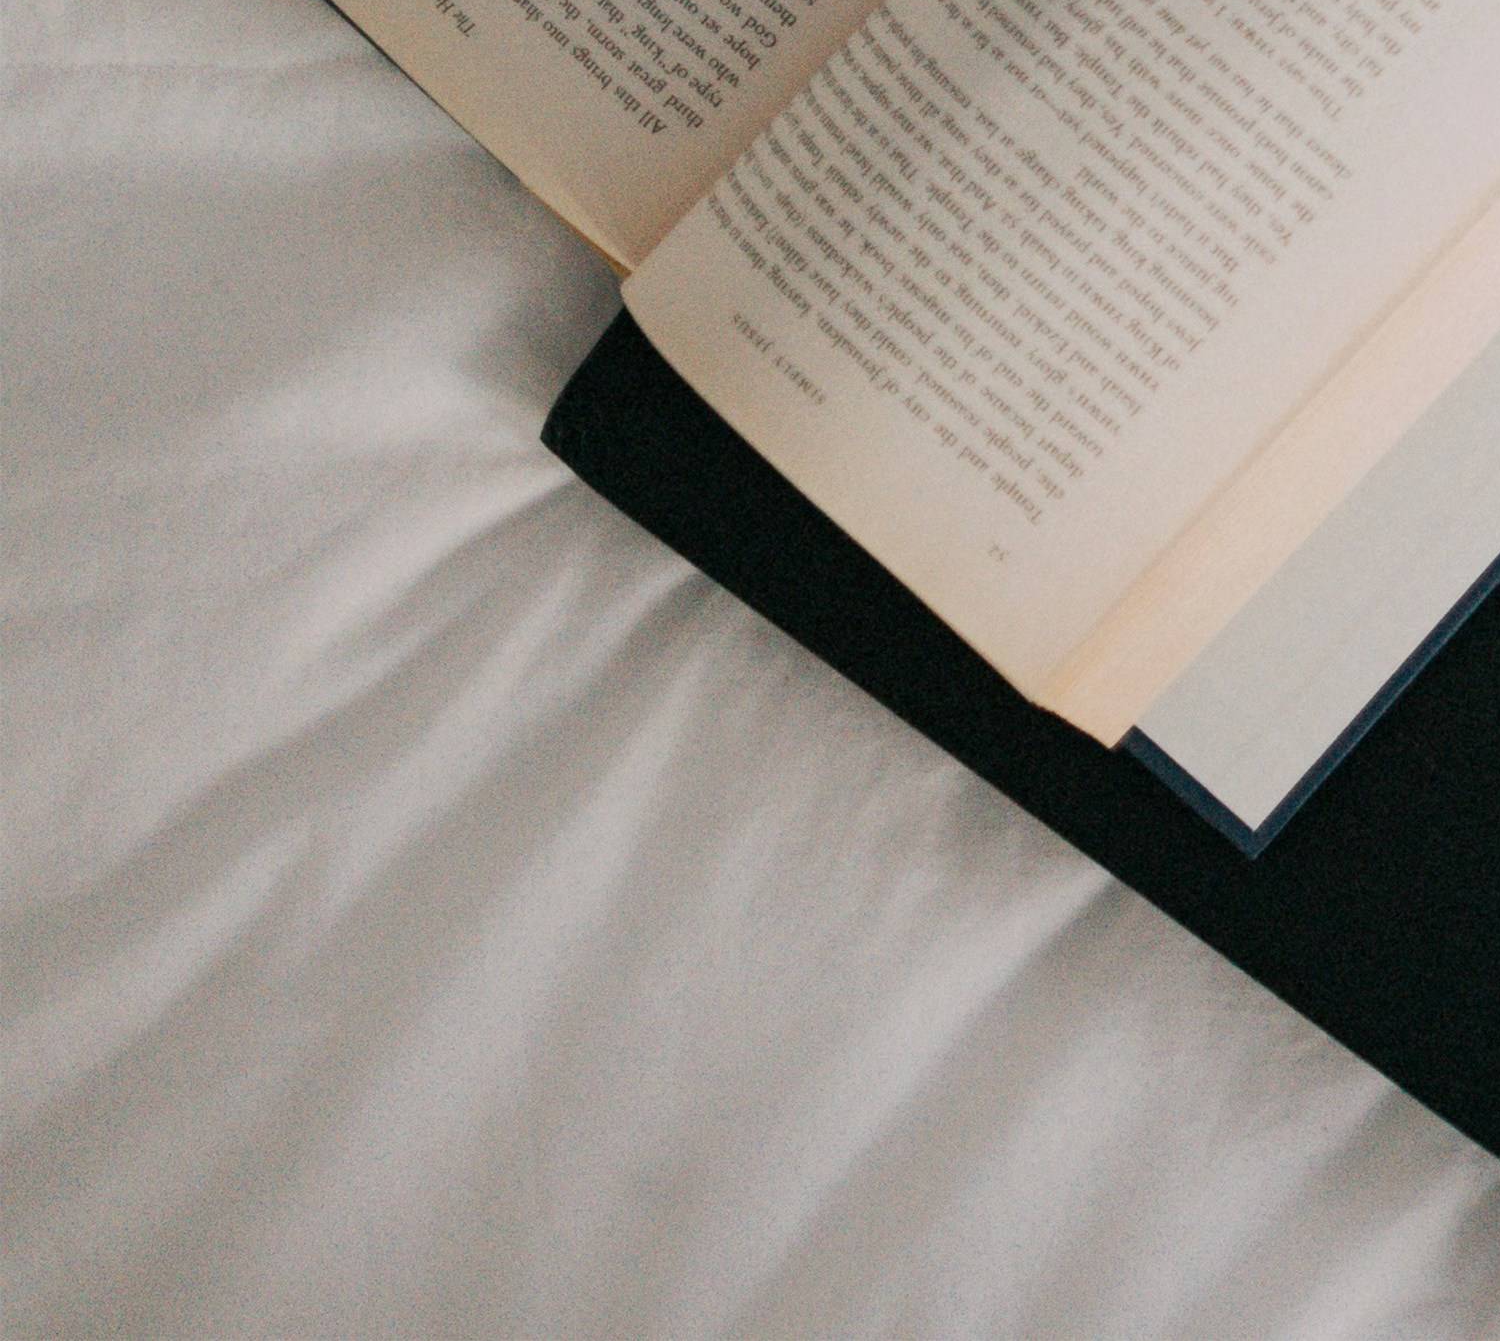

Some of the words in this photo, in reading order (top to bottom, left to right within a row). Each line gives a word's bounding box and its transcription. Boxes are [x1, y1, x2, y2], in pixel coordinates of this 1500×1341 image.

[446, 5, 481, 40] The
[535, 15, 573, 52] into
[564, 39, 618, 91] brings
[607, 80, 644, 116] this
[635, 105, 670, 139] All
[799, 223, 878, 297] wickedness
[807, 310, 886, 384] Jerusalem,
